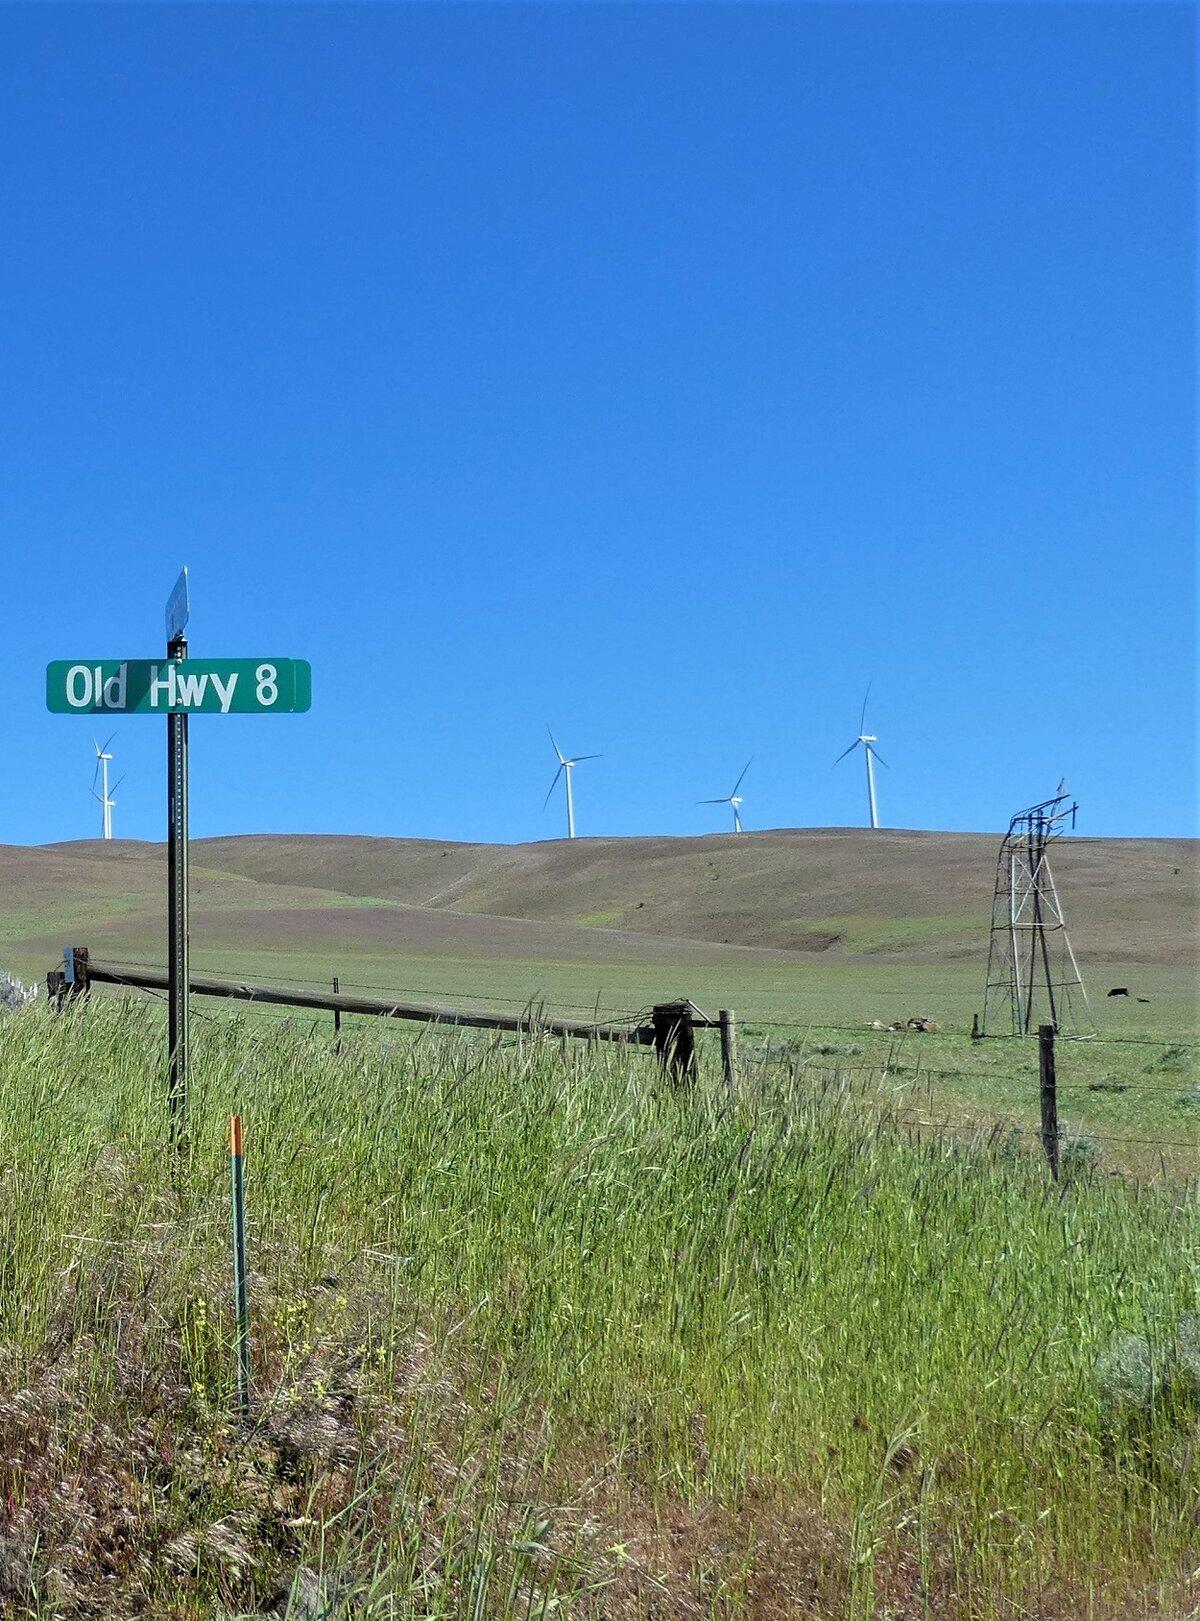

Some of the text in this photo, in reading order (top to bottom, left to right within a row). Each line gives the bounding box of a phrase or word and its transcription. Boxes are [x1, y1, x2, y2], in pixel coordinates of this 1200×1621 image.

[66, 663, 278, 713] Old Hwy 8
